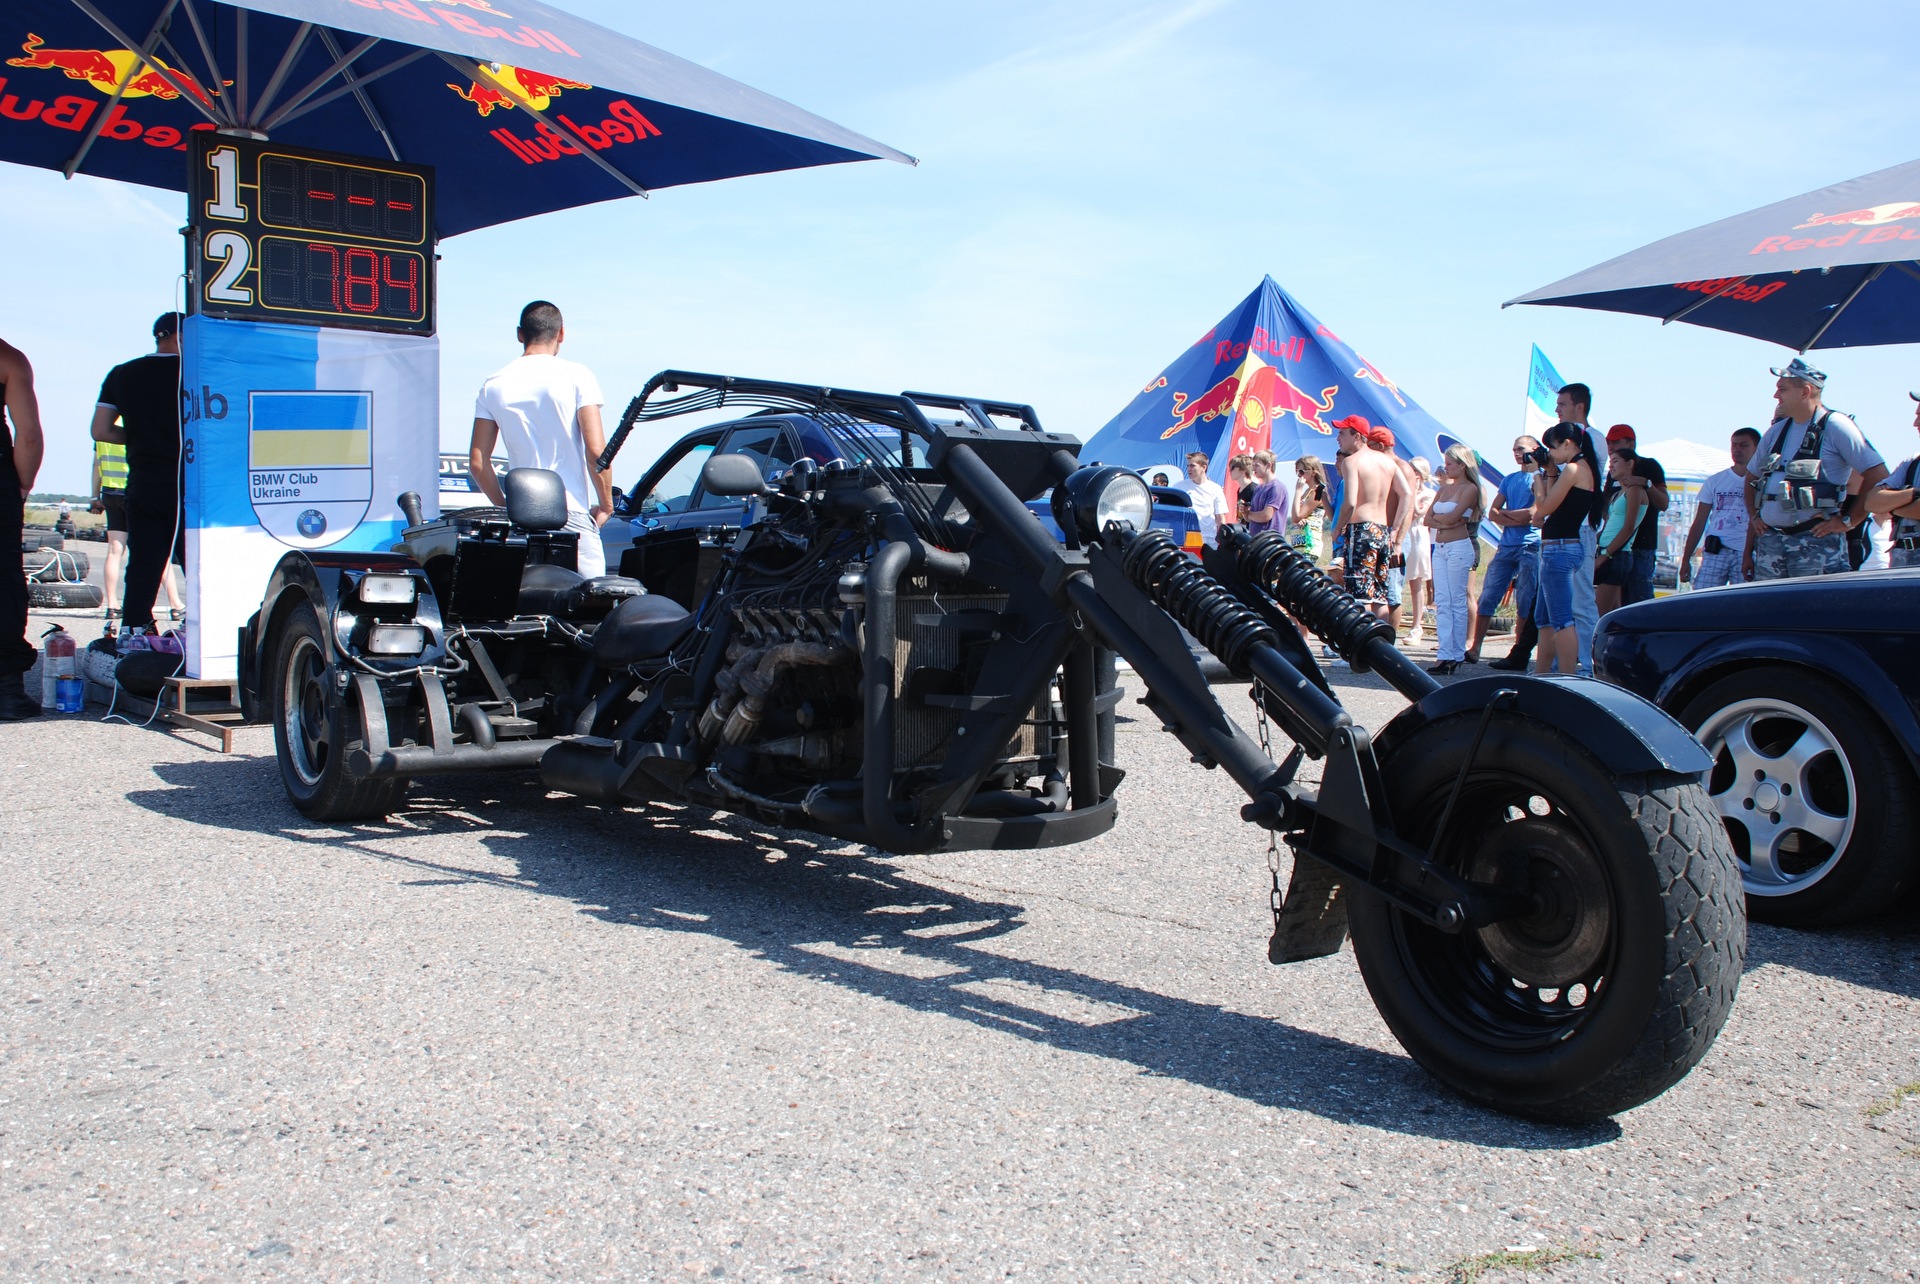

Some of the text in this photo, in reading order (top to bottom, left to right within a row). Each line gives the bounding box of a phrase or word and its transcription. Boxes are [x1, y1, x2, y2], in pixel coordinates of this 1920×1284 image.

[349, 0, 582, 58] ed Bull
[207, 146, 247, 222] 1
[1748, 225, 1920, 255] Red Bu
[206, 230, 252, 305] 2
[1214, 338, 1253, 366] Re
[1252, 326, 1305, 363] Bull
[252, 472, 319, 486] BMW Club
[252, 486, 301, 499] Ukraine
